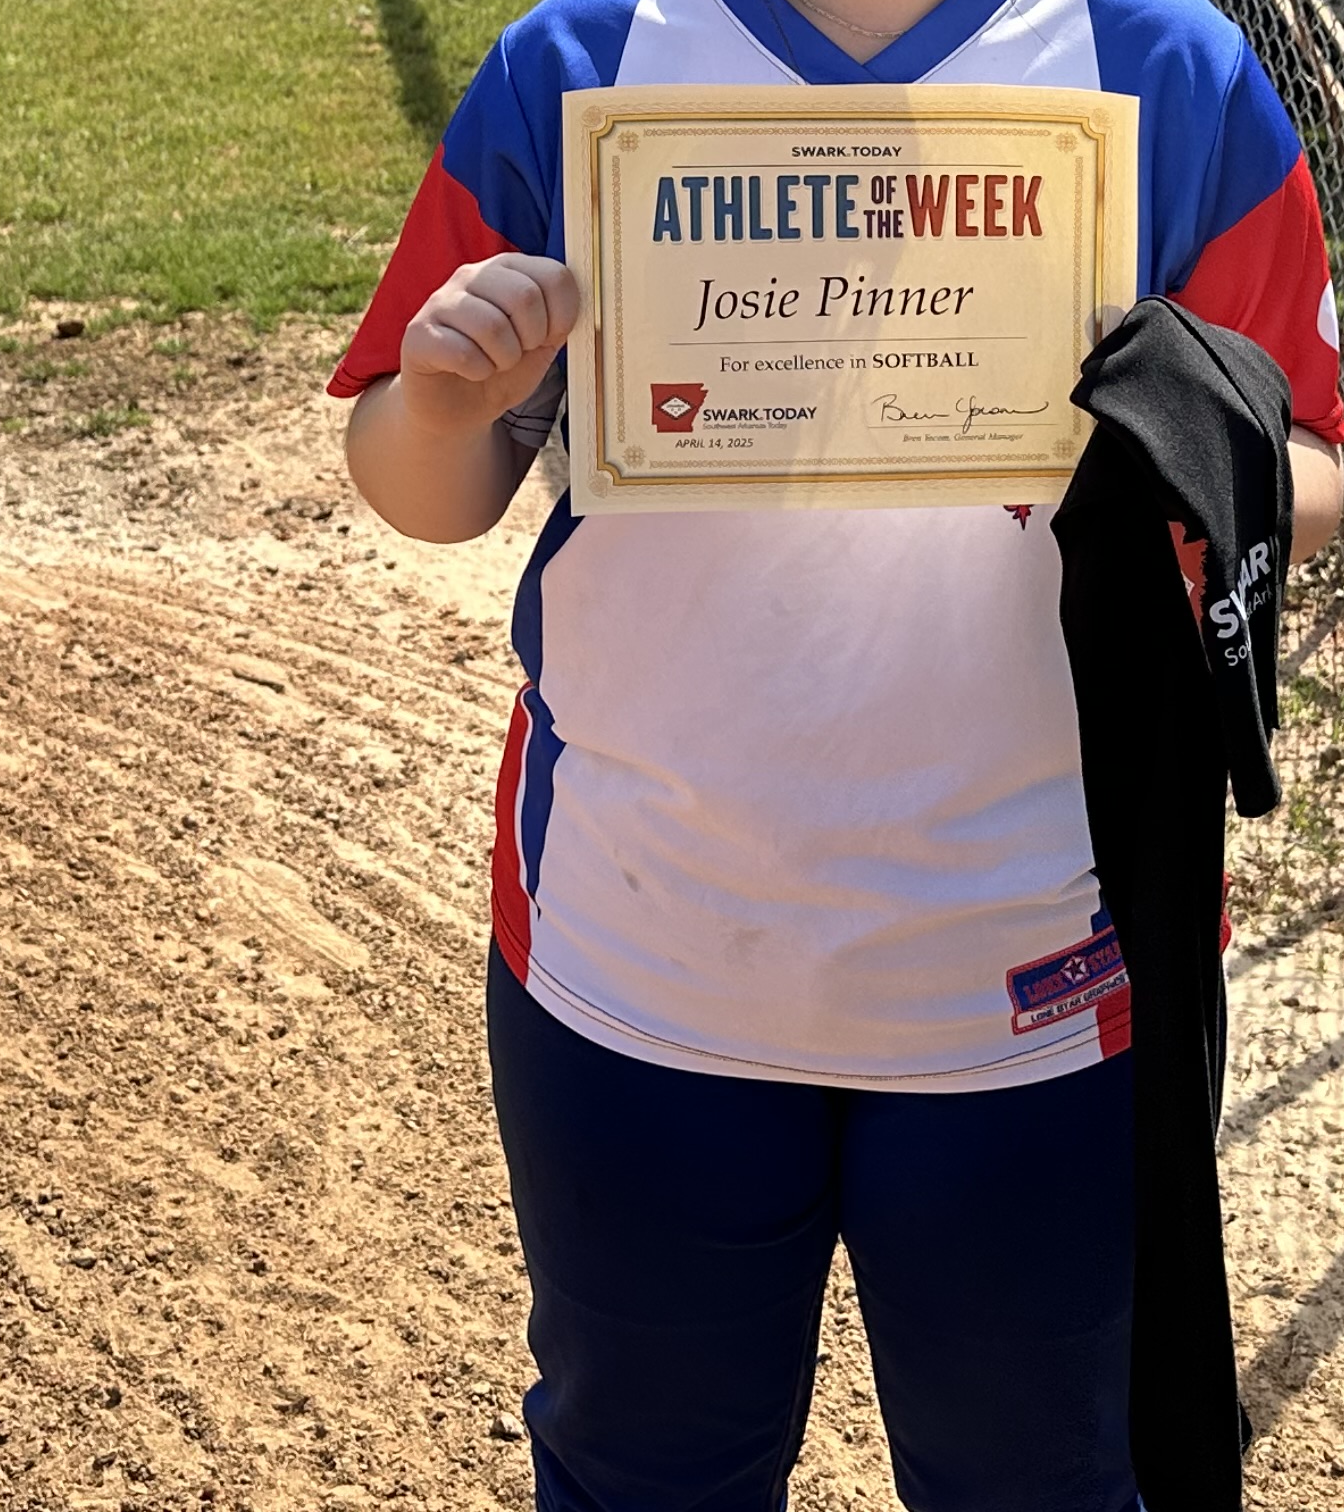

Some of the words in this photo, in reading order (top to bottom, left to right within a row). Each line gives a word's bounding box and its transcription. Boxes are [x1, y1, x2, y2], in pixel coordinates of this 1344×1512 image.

[791, 146, 902, 157] SWARK.TODAY
[871, 175, 898, 204] OF
[652, 174, 860, 242] ATHLETE
[905, 174, 1043, 237] WEEK
[863, 209, 904, 238] THE
[693, 277, 800, 331] Josie
[815, 275, 974, 317] Pinner
[720, 356, 749, 372] For
[754, 354, 845, 371] excellence
[849, 354, 867, 369] in
[872, 352, 980, 368] SOFTBALL
[702, 406, 817, 422] SWARK.TODAY
[675, 439, 706, 449] APRIL
[708, 438, 724, 450] 14,
[726, 438, 754, 448] 2025
[953, 432, 986, 441] General
[987, 432, 1024, 441] Manager
